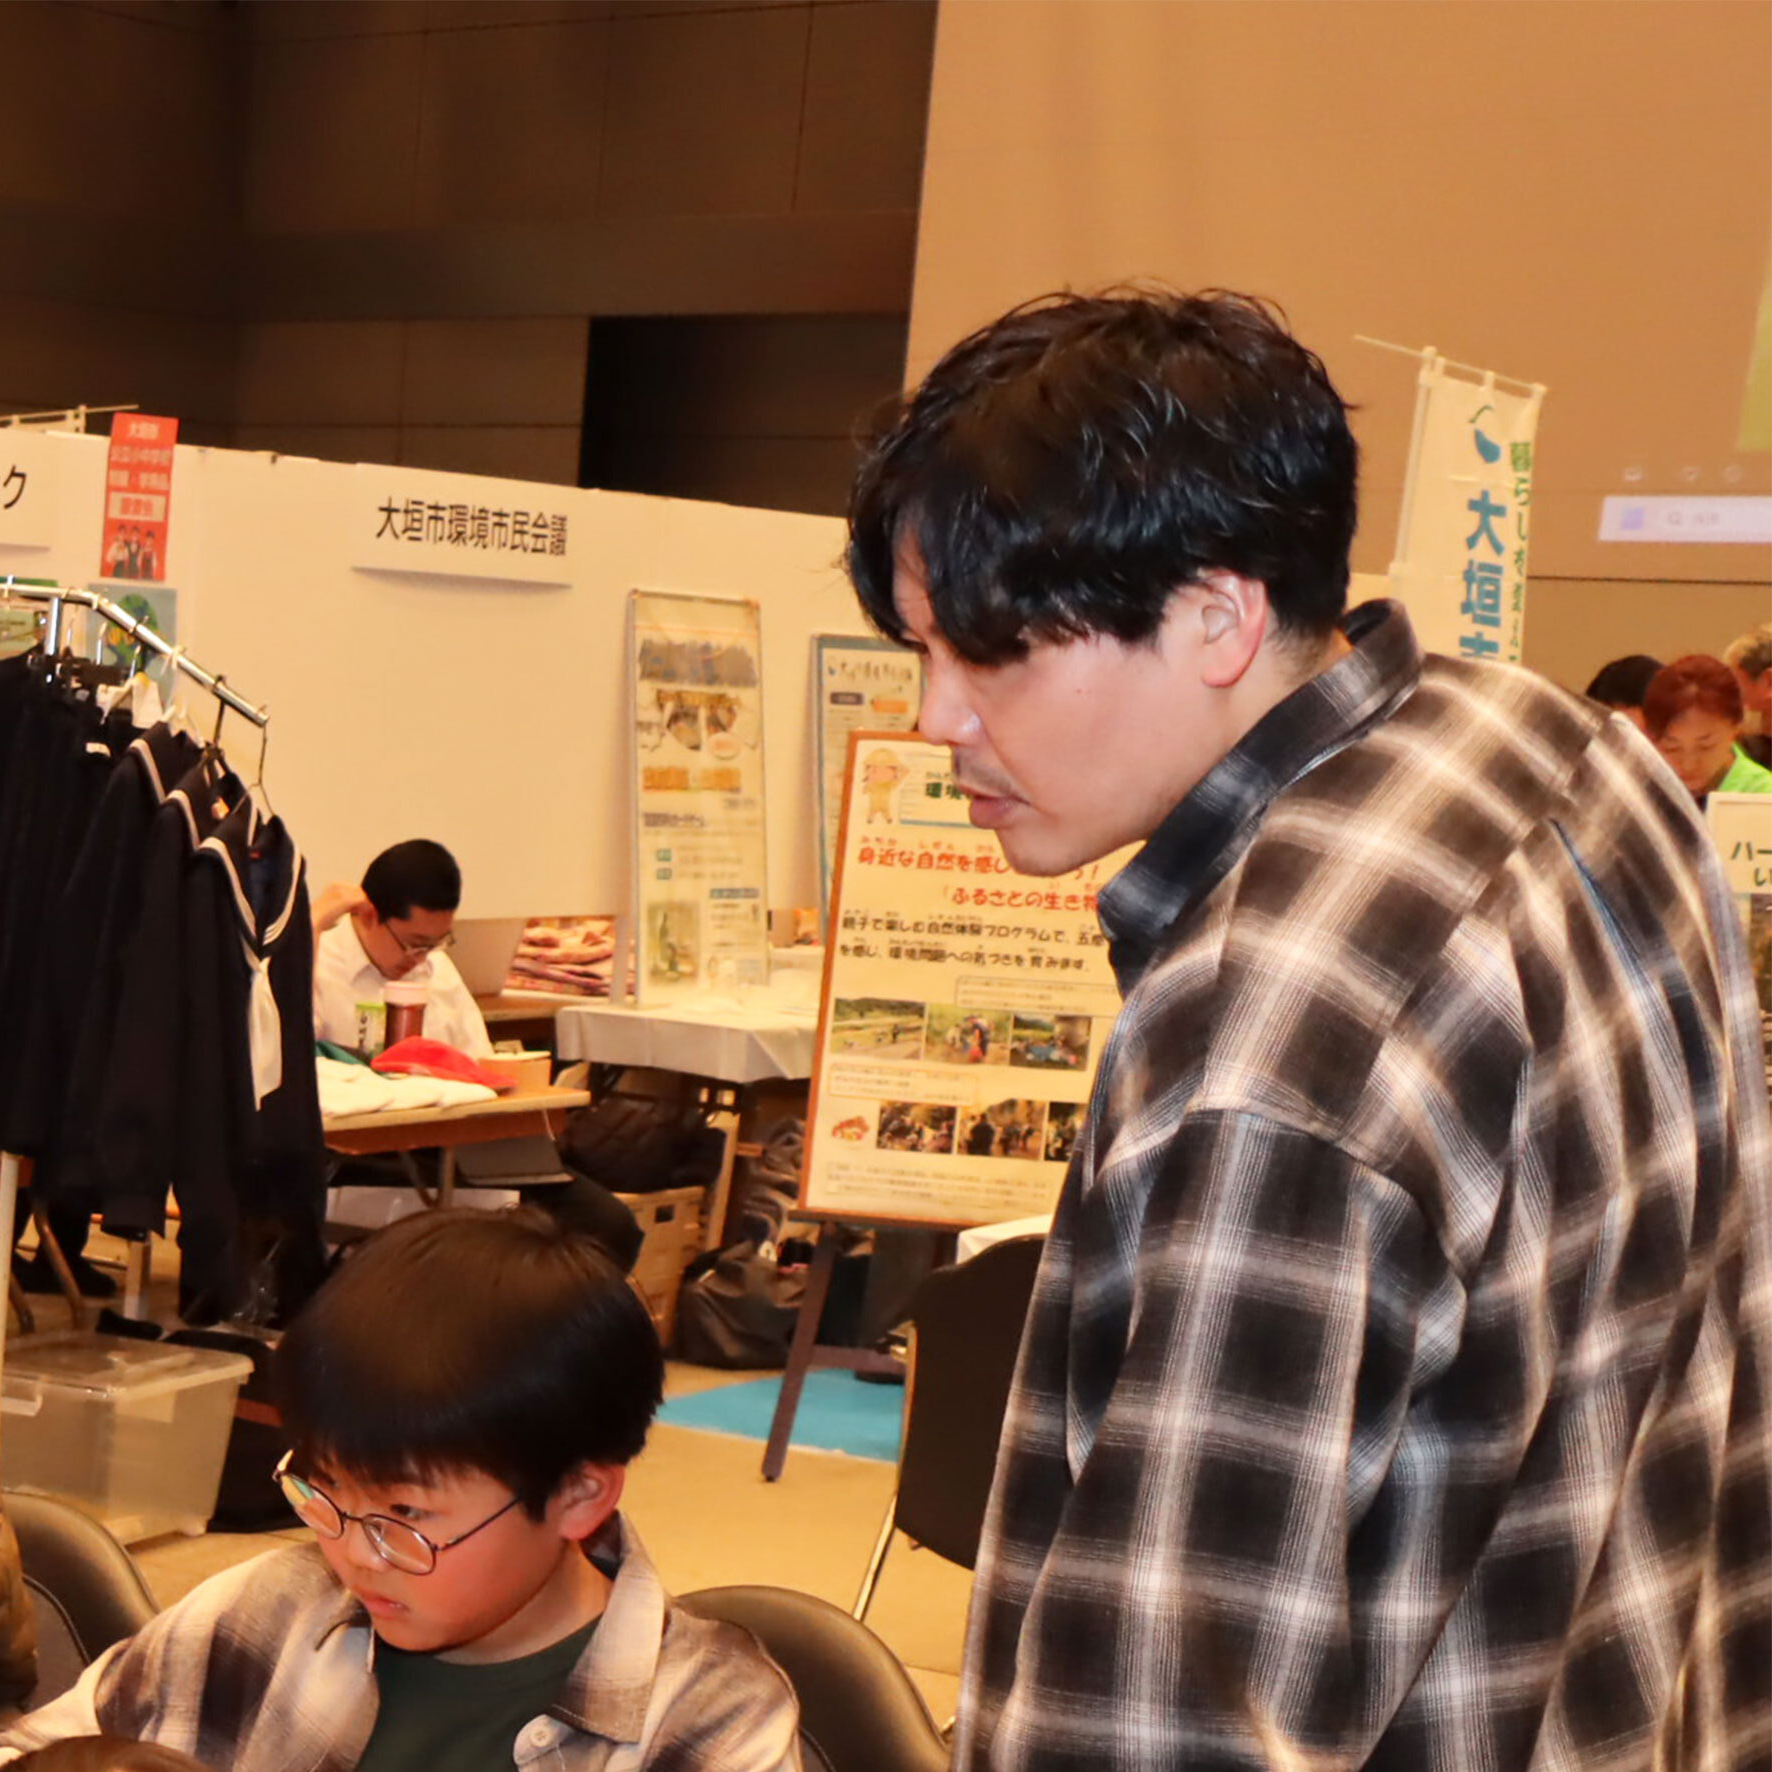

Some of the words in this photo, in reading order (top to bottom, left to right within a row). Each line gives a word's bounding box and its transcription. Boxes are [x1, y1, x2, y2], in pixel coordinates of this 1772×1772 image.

[374, 495, 569, 558] 大垣市環境市民会議
